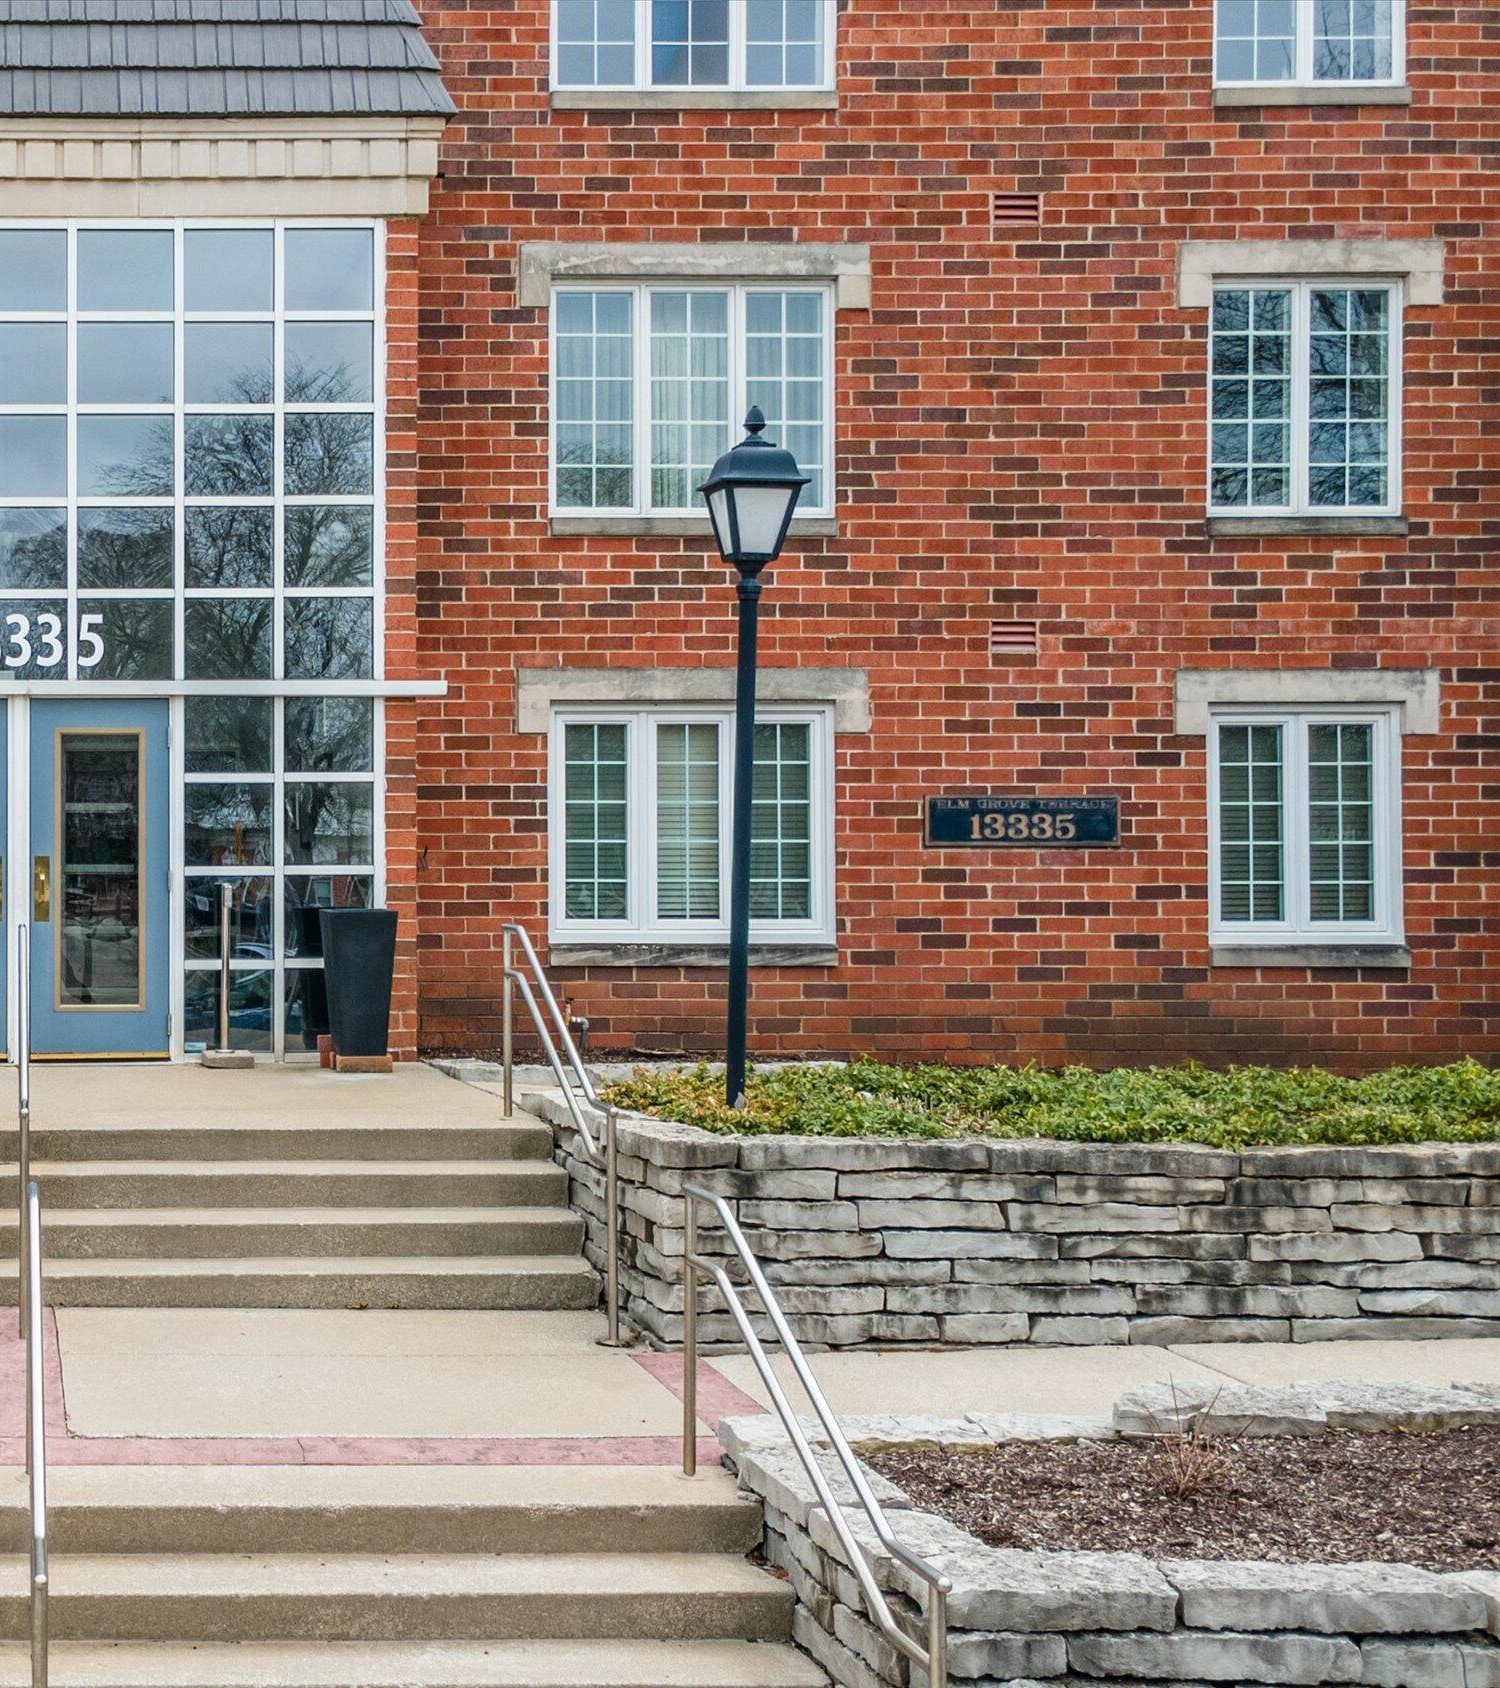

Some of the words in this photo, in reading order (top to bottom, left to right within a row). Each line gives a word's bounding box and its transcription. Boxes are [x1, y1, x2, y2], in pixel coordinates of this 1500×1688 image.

[937, 799, 970, 810] ELM
[977, 799, 1030, 810] GROVE
[970, 813, 1076, 839] 13335
